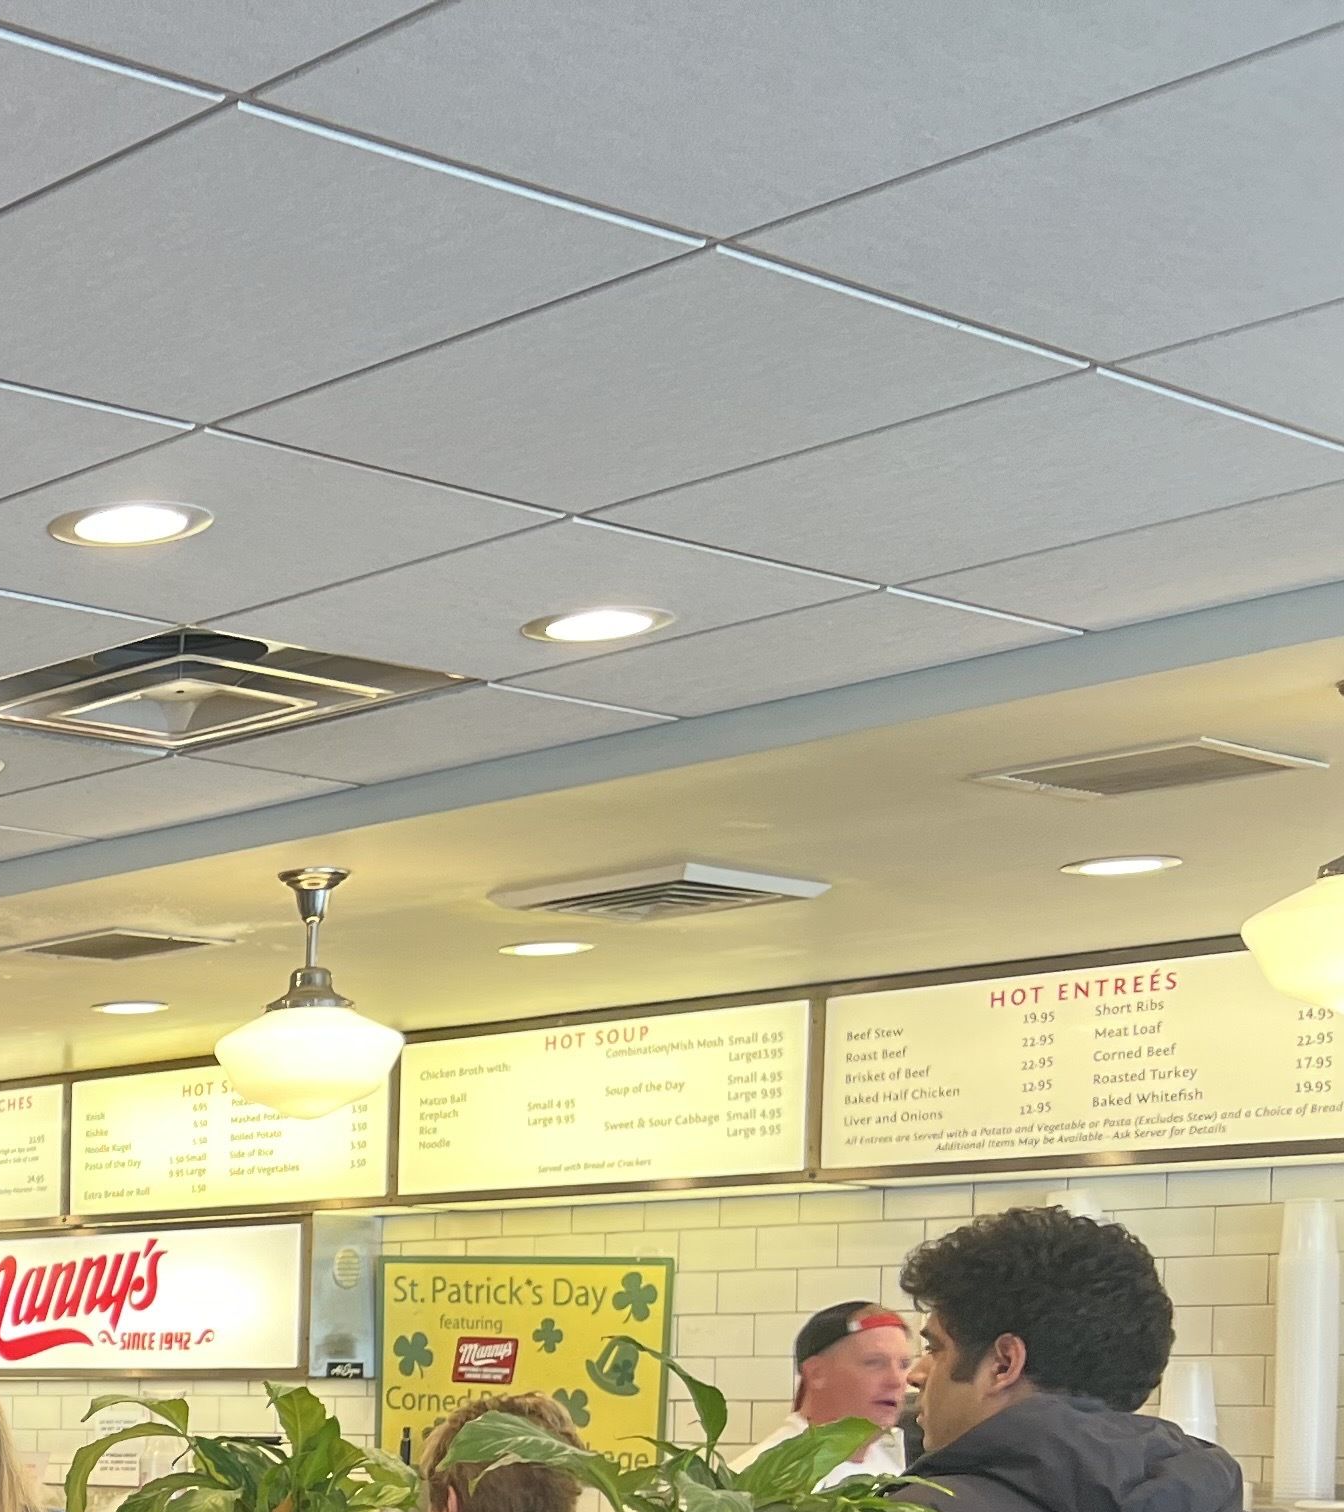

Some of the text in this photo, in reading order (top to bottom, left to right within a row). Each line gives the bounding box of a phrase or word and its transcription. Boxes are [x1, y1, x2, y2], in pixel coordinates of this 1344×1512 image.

[990, 968, 1179, 1008] HOT ENTREÉS
[1094, 999, 1166, 1017] Short Ribs
[1297, 1008, 1334, 1021] 14.95
[1023, 1010, 1056, 1024] 19.95
[544, 1025, 650, 1051] HOT SOUP
[846, 1026, 904, 1042] Beef Stew
[1094, 1021, 1163, 1039] Meat Loaf
[696, 1036, 724, 1049] Mosh
[728, 1032, 759, 1046] Small
[1021, 1034, 1055, 1048] 22.95
[1296, 1032, 1333, 1047] 22.95
[845, 1045, 908, 1063] Roast Beef
[1093, 1042, 1177, 1061] Corned Beef
[1021, 1057, 1054, 1071] 22.95
[1296, 1056, 1333, 1070] 17.95
[420, 1067, 457, 1081] Chicken
[459, 1063, 485, 1077] Broth
[727, 1071, 758, 1086] Small
[845, 1065, 932, 1084] Brisket of Beef
[1093, 1066, 1198, 1085] Roasted Turkey
[182, 1081, 215, 1098] HOT
[604, 1080, 686, 1098] Soup of the Day
[1021, 1079, 1053, 1093] 12.95
[1295, 1080, 1332, 1093] 19.95
[450, 1092, 468, 1104] Ball
[727, 1088, 757, 1103] Large
[844, 1086, 961, 1105] Baked Half Chicken
[1093, 1088, 1204, 1108] Baked Whitefish
[527, 1099, 554, 1112] Small
[1019, 1101, 1052, 1115] 12.95
[527, 1114, 554, 1128] Large
[604, 1120, 634, 1132] Sweet
[648, 1115, 673, 1128] Sour
[674, 1112, 720, 1127] Cabbage
[726, 1108, 757, 1122] Small
[843, 1110, 944, 1128] Liver and Onions
[844, 1136, 858, 1146] All
[895, 1134, 911, 1143] are
[913, 1130, 944, 1142] Served
[946, 1128, 969, 1140] with
[1014, 1124, 1034, 1135] and
[1037, 1119, 1085, 1134] Vegetable
[1087, 1120, 1099, 1129] or
[1102, 1117, 1131, 1128] Pasta
[1133, 1114, 1184, 1128] (Excludes
[1187, 1110, 1217, 1123] Stew)
[1220, 1109, 1241, 1120] and
[1255, 1105, 1293, 1118] Choice
[1295, 1103, 1308, 1117] of
[1310, 1101, 1344, 1113] Bread
[419, 1125, 437, 1136] Rice
[726, 1125, 757, 1140] Large
[936, 1122, 1227, 1152] Additional Items May be Available Ask Server for Details
[418, 1137, 451, 1150] Noodle
[393, 1276, 608, 1316] St. Patrick's Day
[439, 1314, 503, 1334] featuring
[119, 1332, 192, 1351] SINCE 1942
